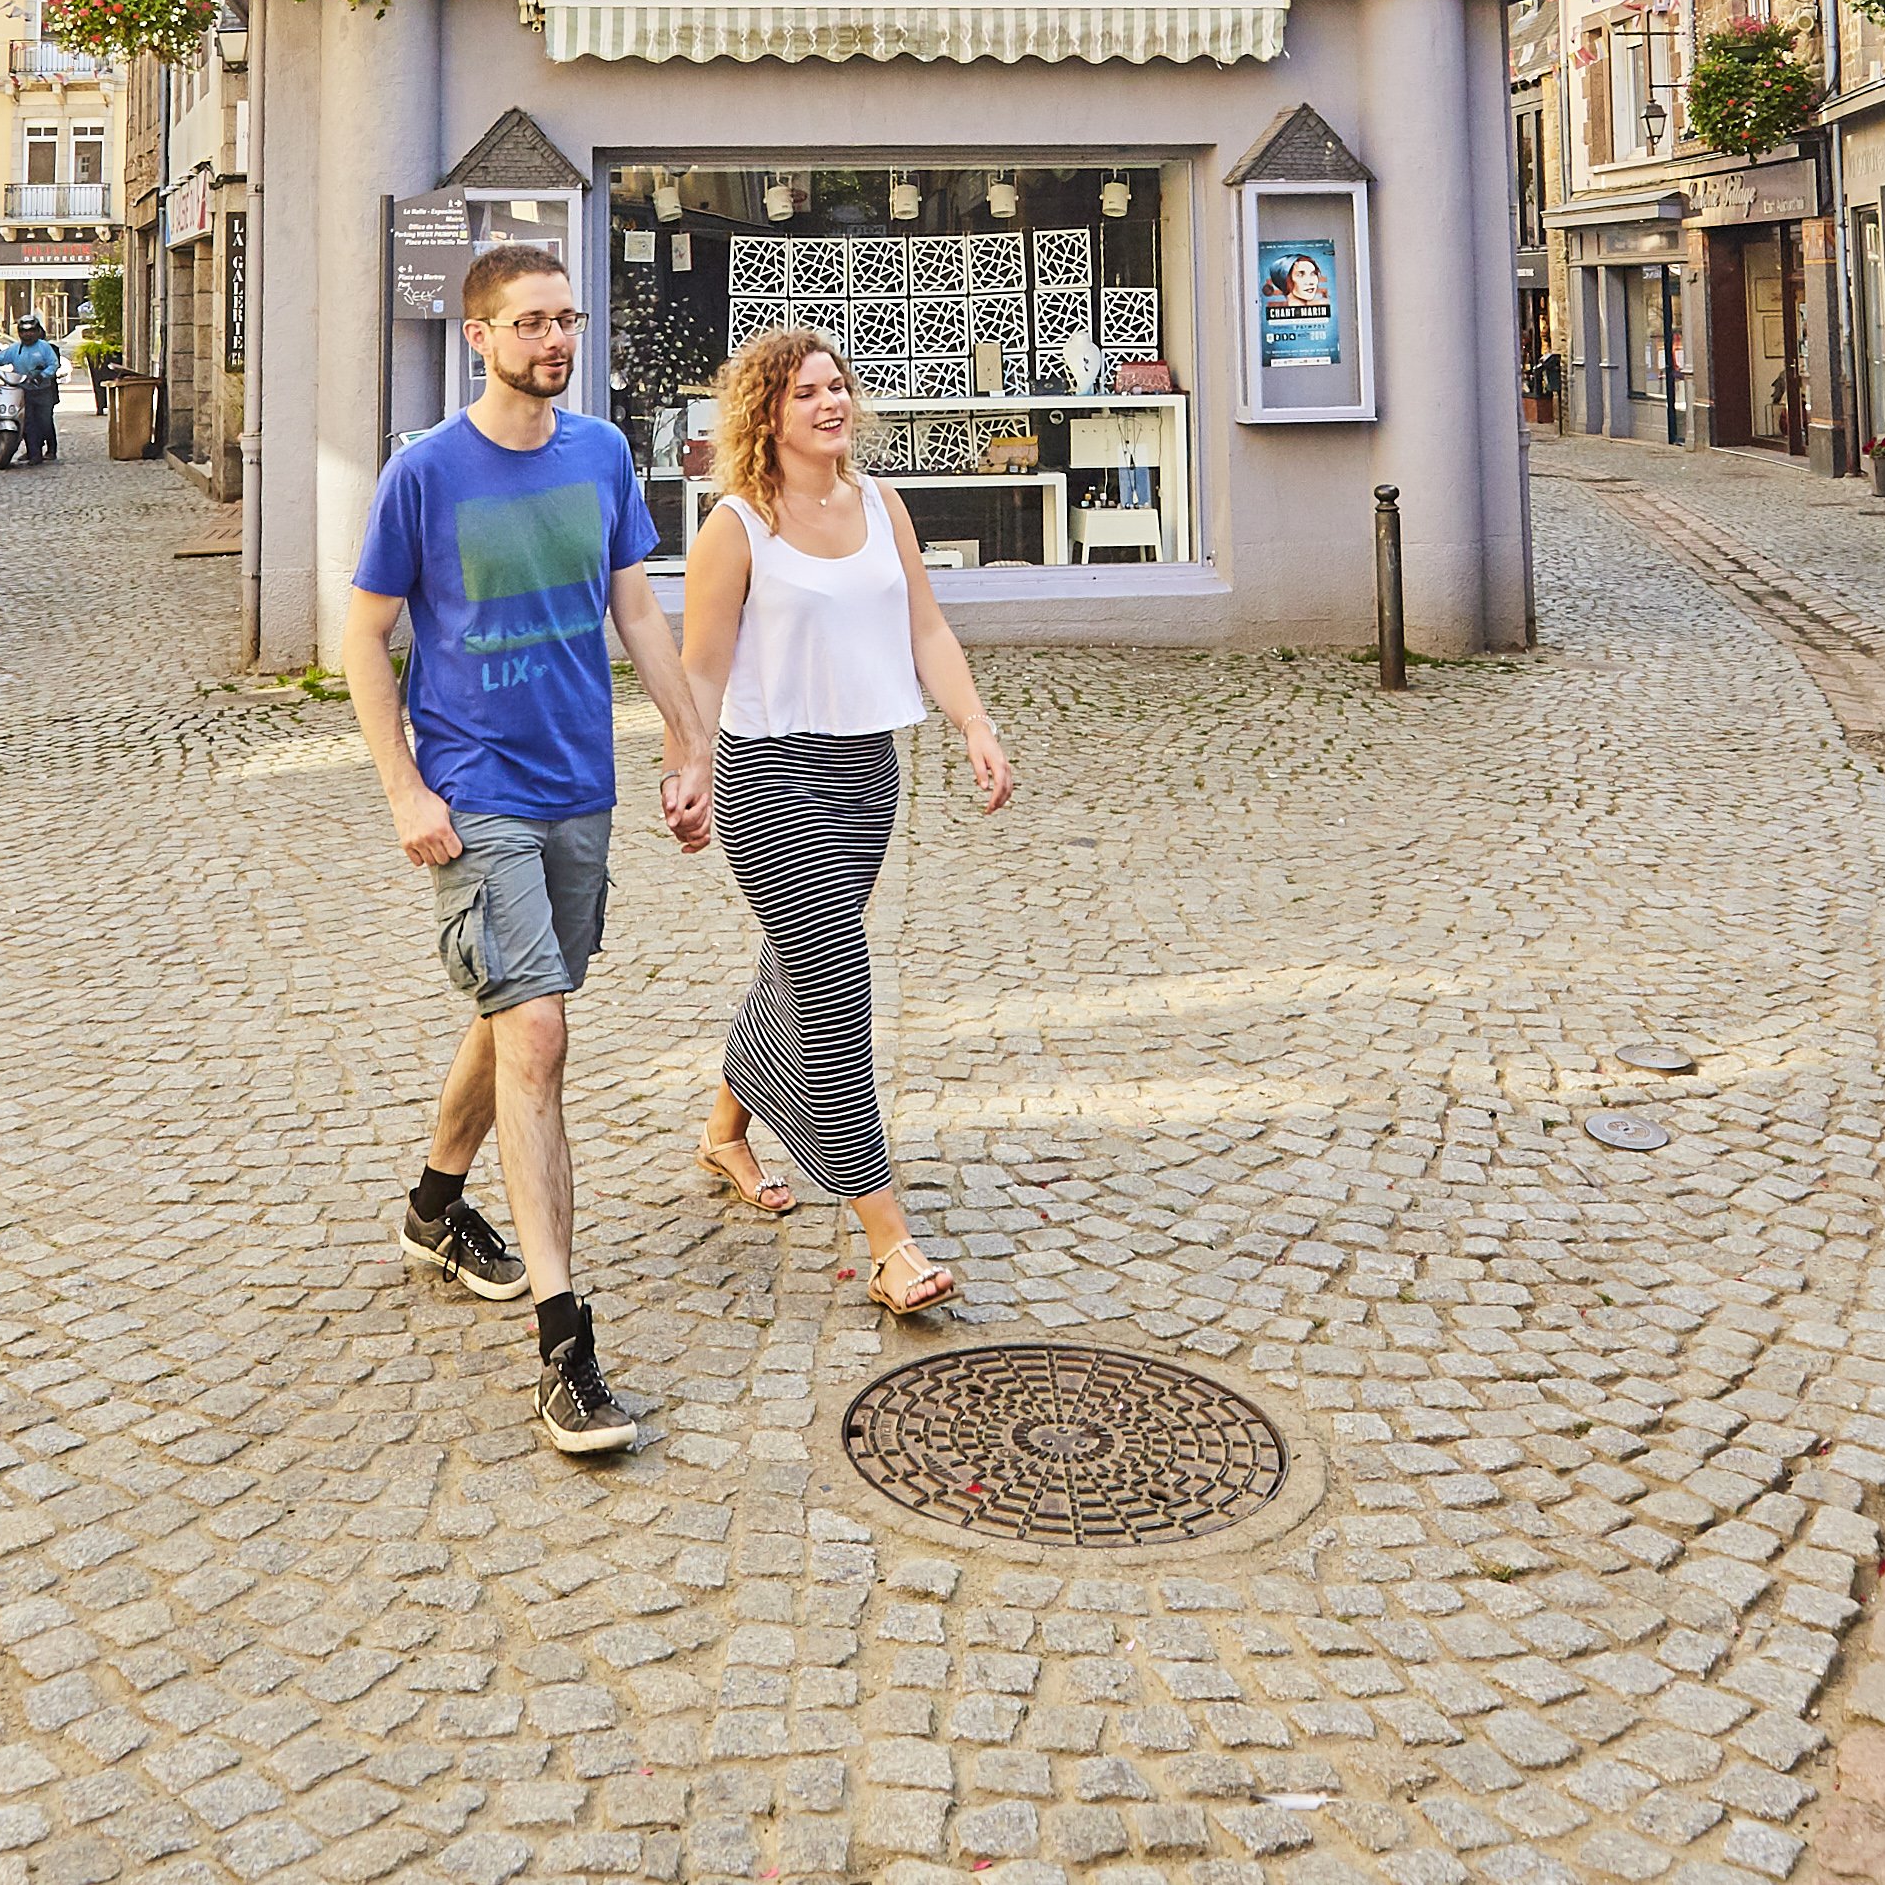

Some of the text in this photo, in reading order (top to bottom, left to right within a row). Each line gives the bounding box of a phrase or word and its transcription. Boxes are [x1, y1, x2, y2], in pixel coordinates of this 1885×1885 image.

[232, 220, 244, 246] LA
[232, 256, 244, 349] GALERIE
[1270, 307, 1327, 318] CHANT MARIN
[481, 655, 529, 692] LIX
